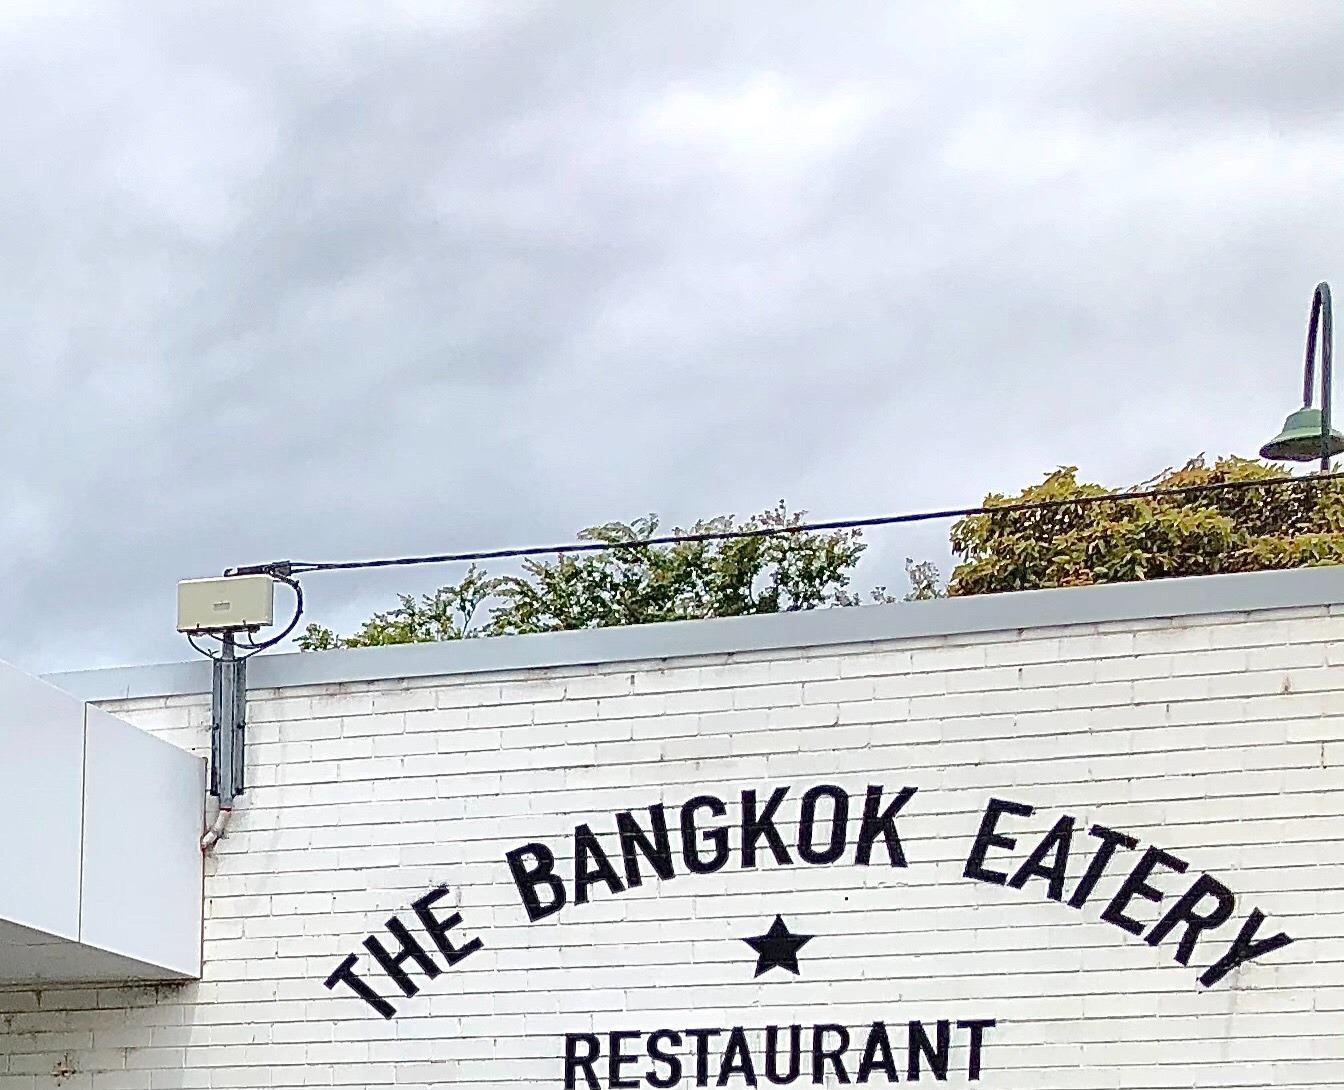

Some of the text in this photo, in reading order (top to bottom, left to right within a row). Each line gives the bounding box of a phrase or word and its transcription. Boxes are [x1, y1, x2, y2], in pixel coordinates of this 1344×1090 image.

[324, 784, 1295, 1021] THE BANGKOK EATERY
